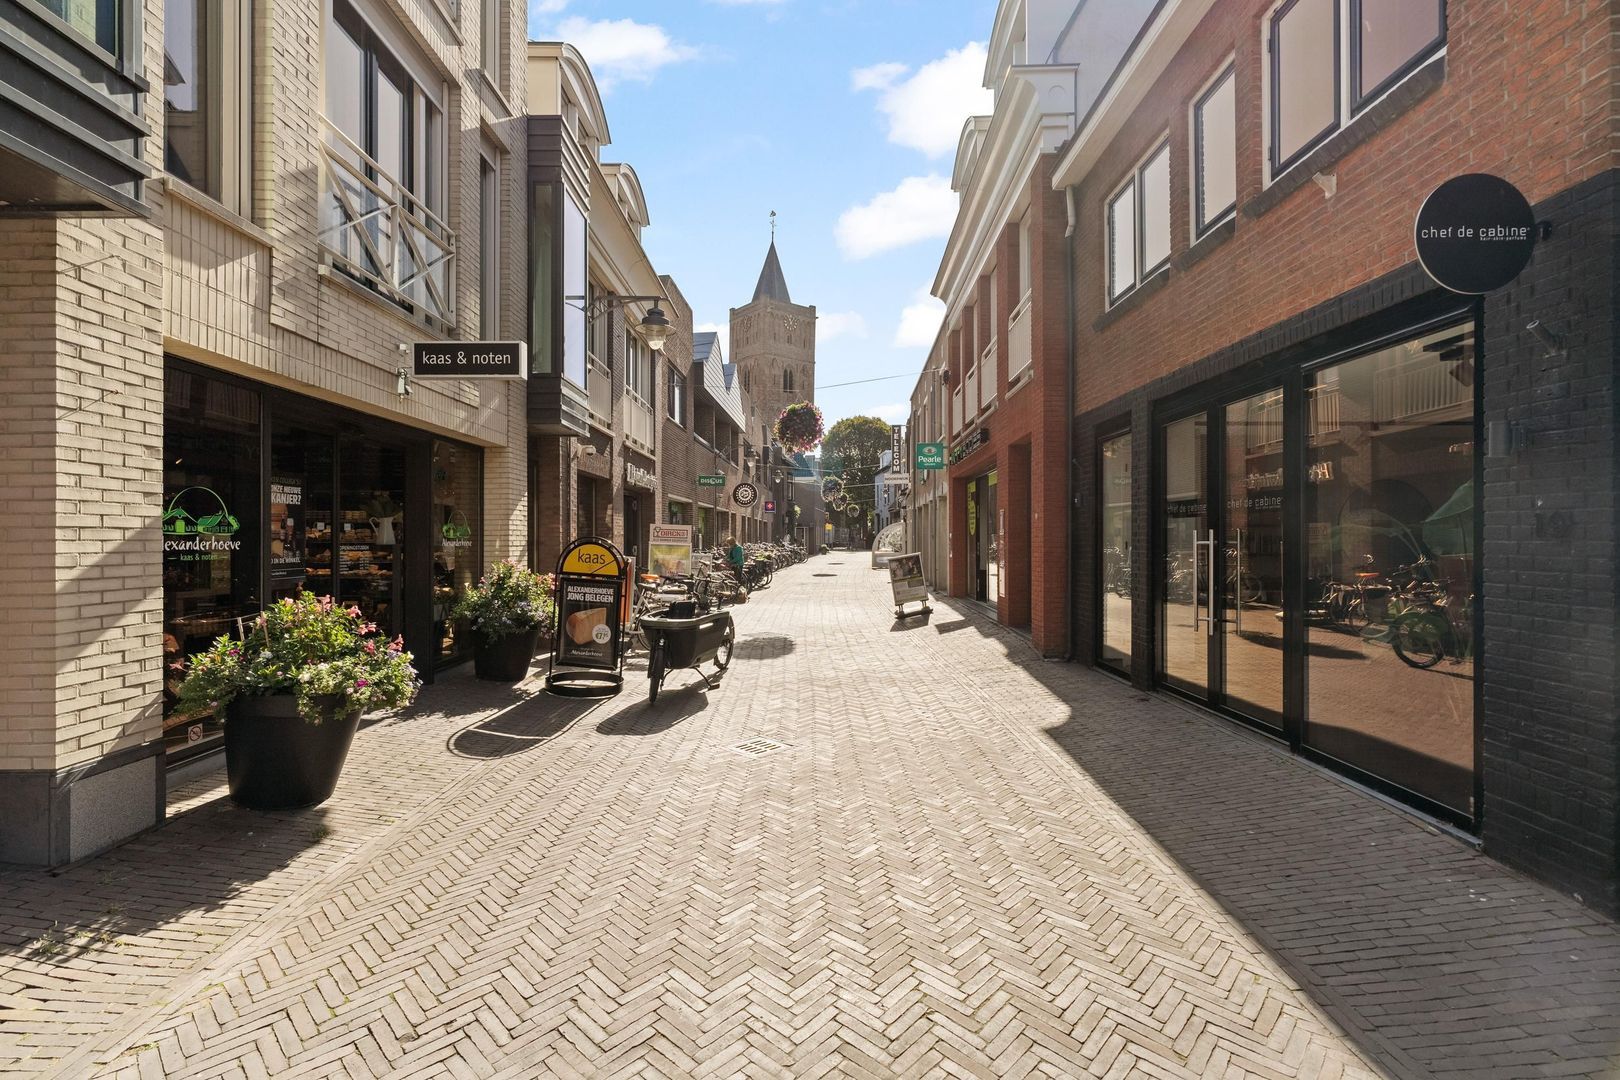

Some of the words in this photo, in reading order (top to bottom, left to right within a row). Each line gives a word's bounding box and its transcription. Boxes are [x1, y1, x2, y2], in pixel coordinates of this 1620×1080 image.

[1421, 226, 1452, 238] chef
[1457, 225, 1473, 238] de
[1479, 225, 1527, 236] cabine
[422, 350, 452, 365] kaas
[457, 351, 467, 364] &
[472, 352, 511, 364] noten
[284, 486, 302, 495] NIEUWE
[271, 493, 302, 505] KANJER?
[180, 553, 194, 561] kaas
[195, 553, 200, 561] &
[201, 553, 219, 561] noten
[577, 549, 606, 565] kaas
[567, 585, 615, 595] ALEXANDERHOEVE
[567, 592, 584, 601] JONG
[585, 593, 614, 603] BELEGEN
